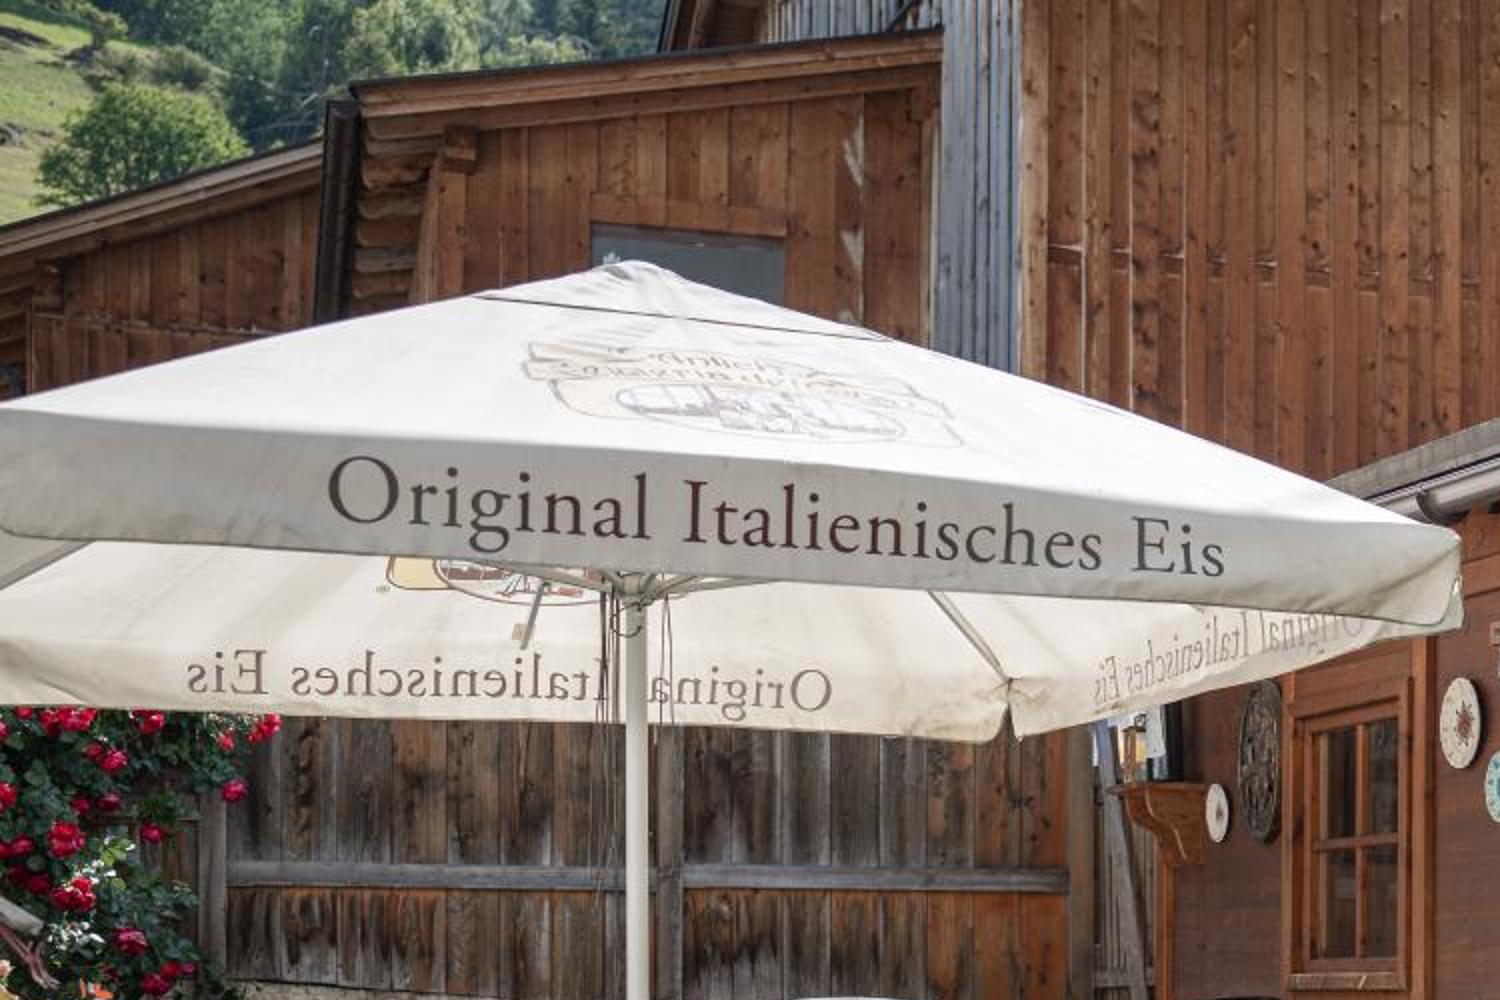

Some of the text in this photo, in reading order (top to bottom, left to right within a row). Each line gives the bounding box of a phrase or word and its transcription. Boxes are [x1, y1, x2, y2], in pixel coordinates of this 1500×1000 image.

[328, 456, 1225, 577] Original Italienisches Eis
